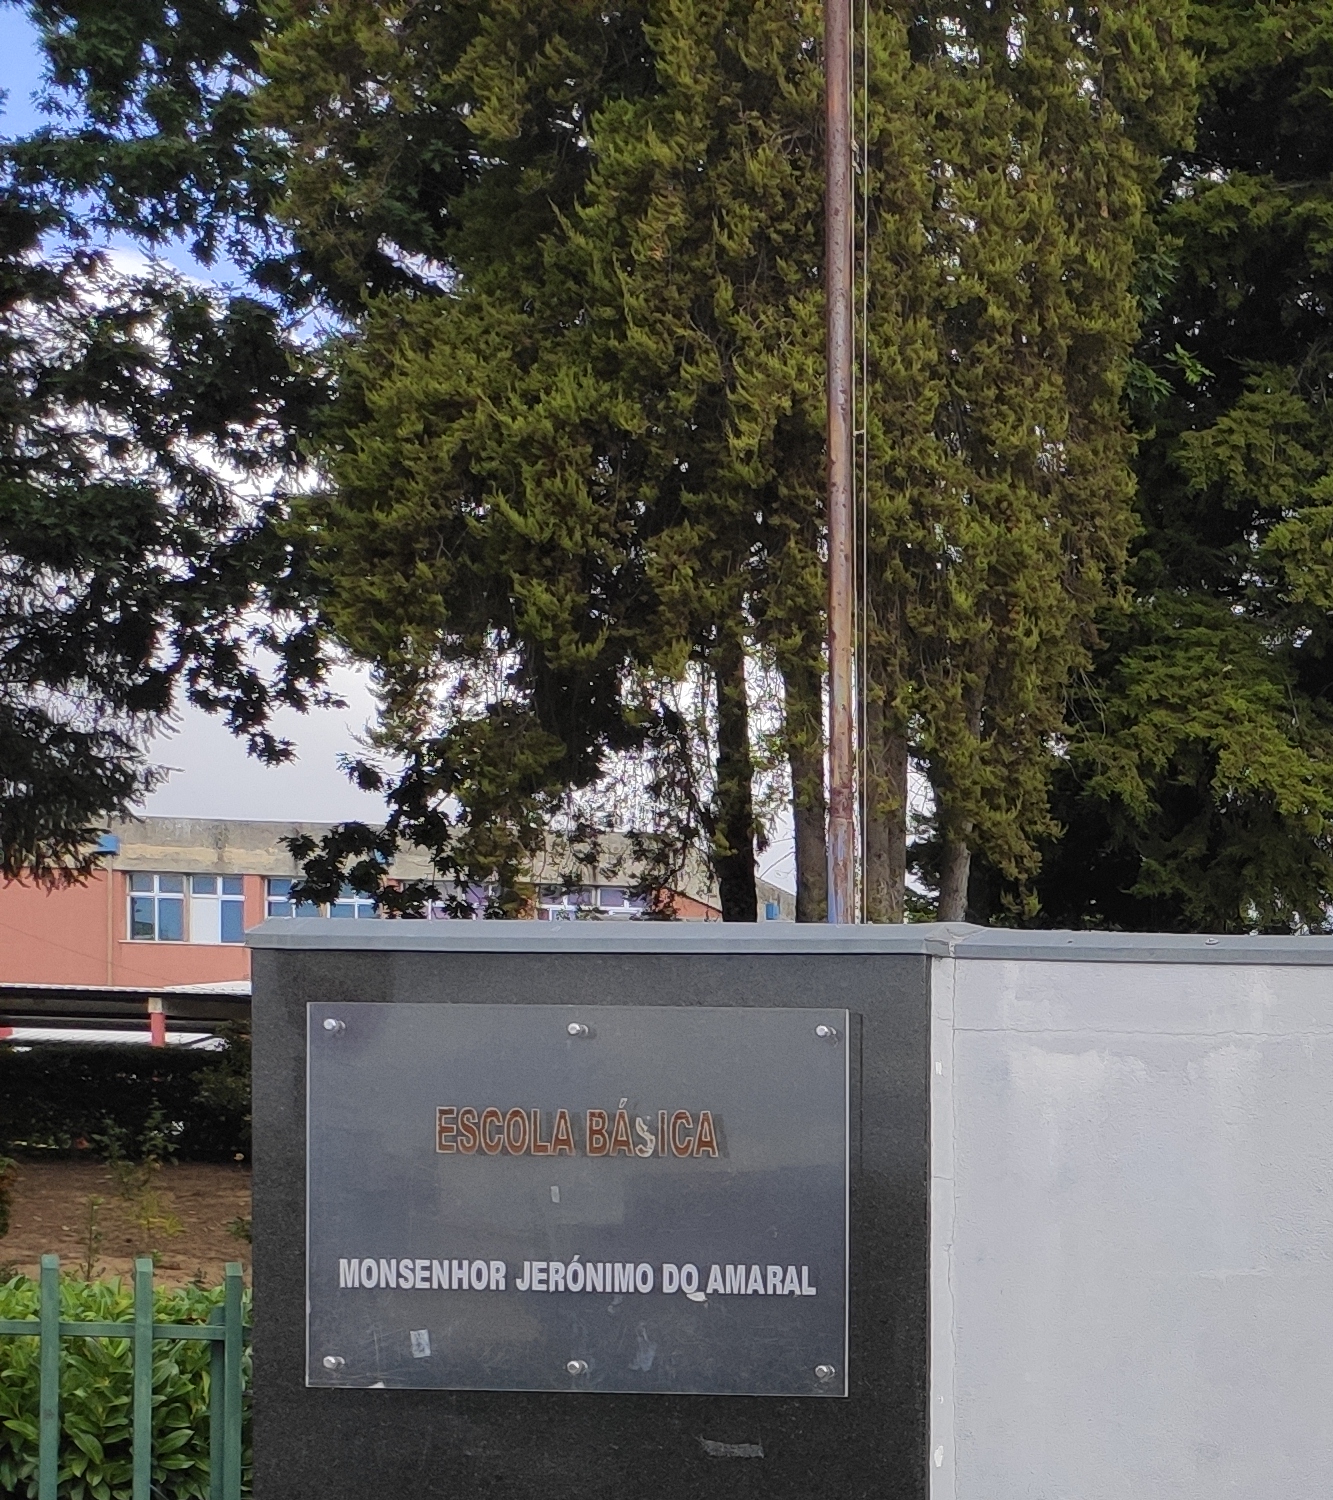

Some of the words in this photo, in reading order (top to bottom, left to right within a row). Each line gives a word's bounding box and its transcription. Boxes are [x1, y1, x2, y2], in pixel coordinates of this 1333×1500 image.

[435, 1107, 573, 1155] ESCOLA
[586, 1098, 719, 1157] BÁSICA
[339, 1258, 506, 1290] MONSENHOR
[515, 1254, 654, 1293] JERÓNIMO
[662, 1263, 699, 1294] DO
[706, 1265, 817, 1296] AMARAL
